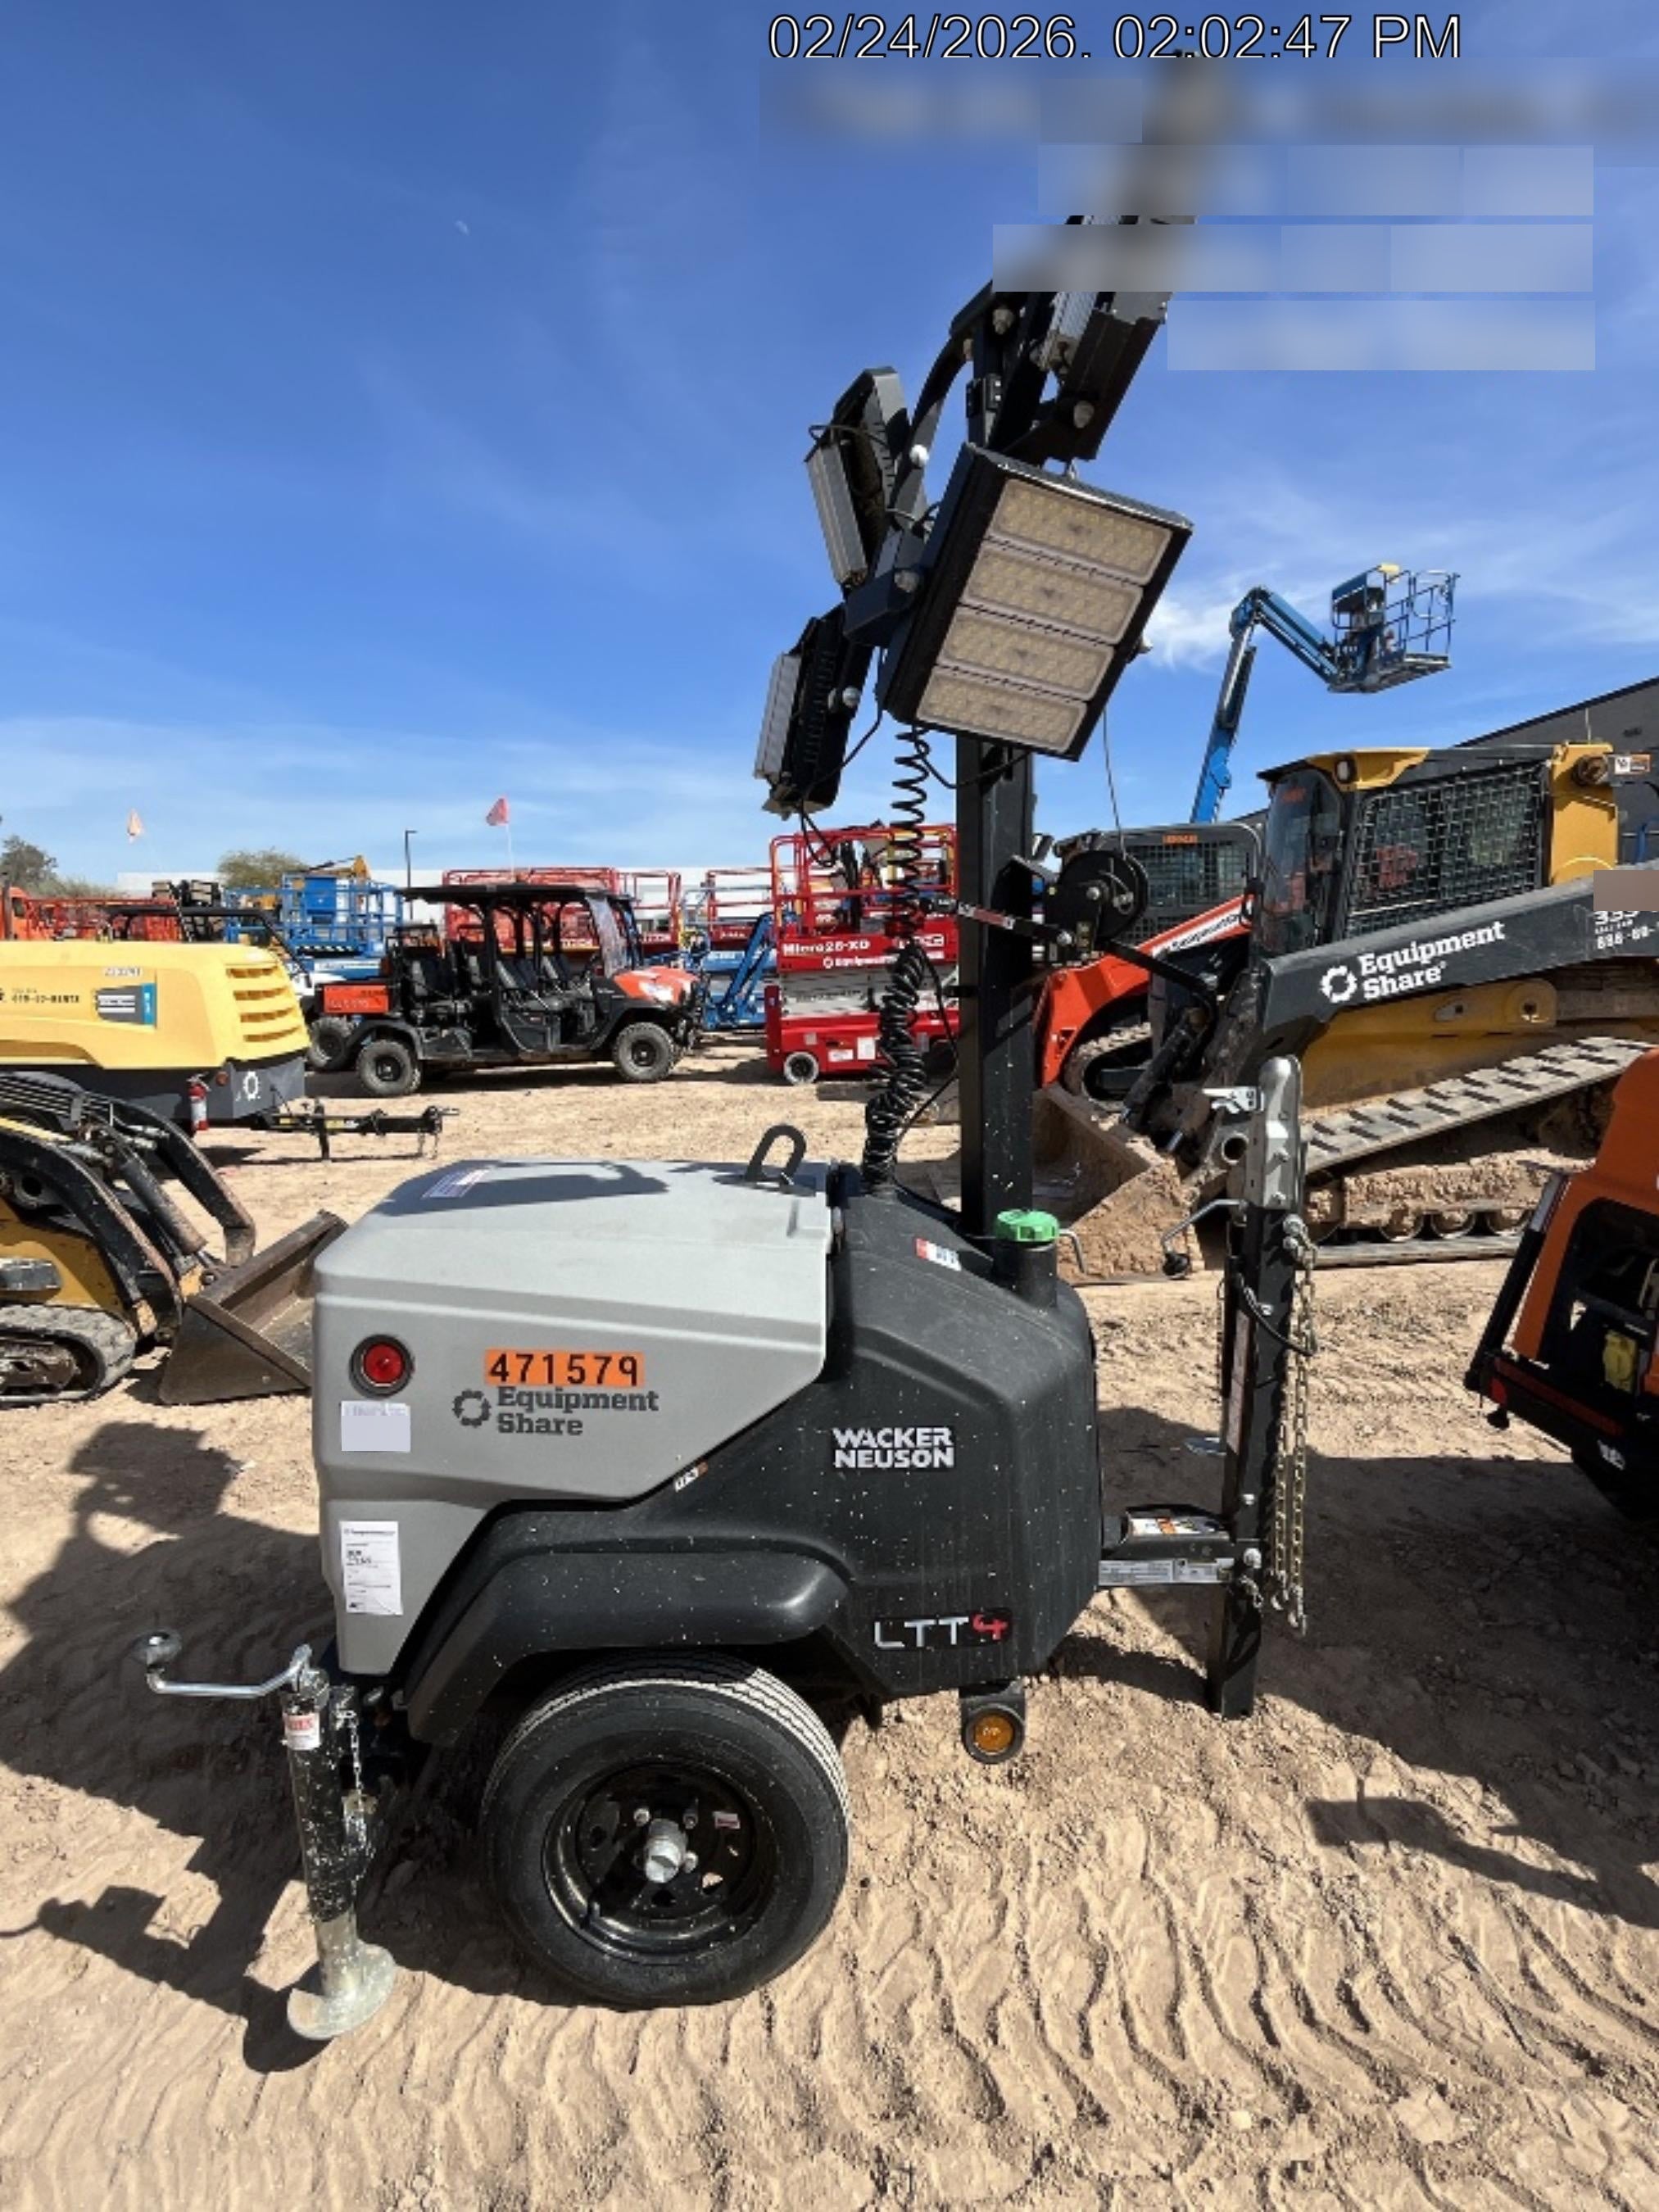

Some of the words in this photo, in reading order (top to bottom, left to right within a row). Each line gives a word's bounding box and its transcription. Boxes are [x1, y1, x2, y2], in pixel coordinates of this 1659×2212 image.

[1358, 921, 1506, 976] Equipment
[1362, 966, 1442, 1000] Share
[488, 1353, 637, 1386] 471579
[497, 1386, 659, 1413] Equipment
[497, 1412, 583, 1435] Share
[832, 1427, 954, 1448] WACKER
[834, 1447, 954, 1469] NEUSON
